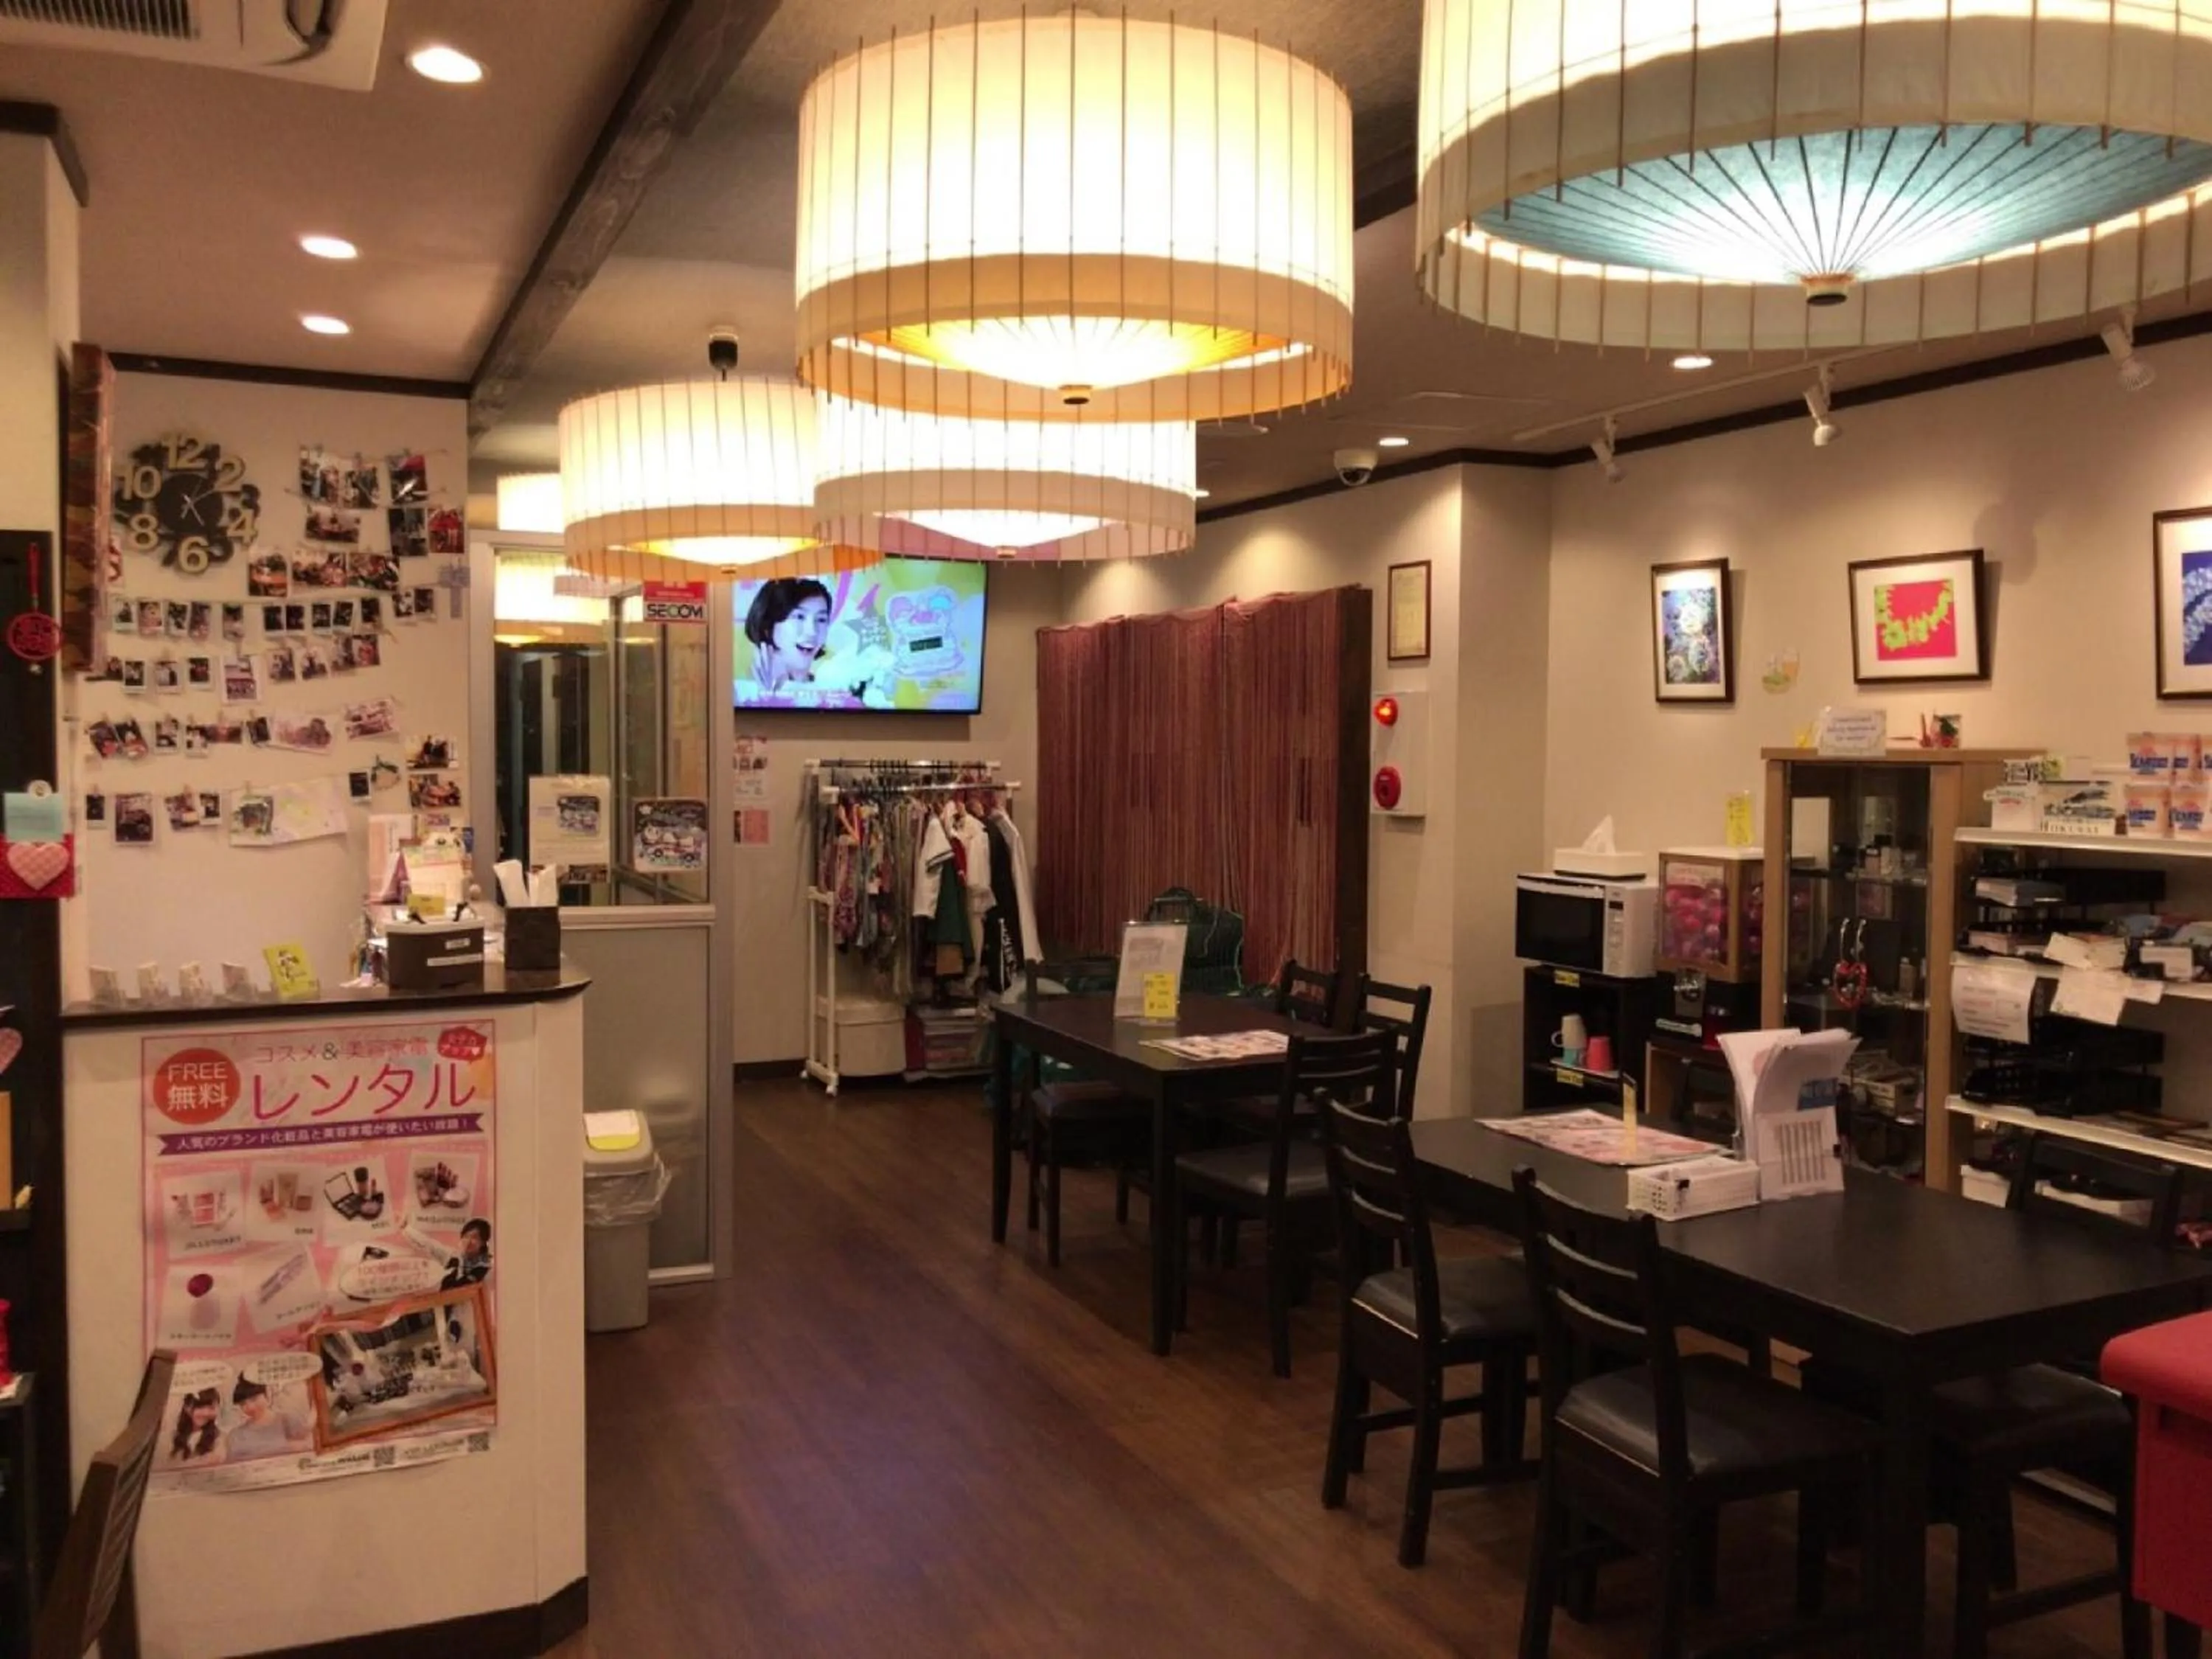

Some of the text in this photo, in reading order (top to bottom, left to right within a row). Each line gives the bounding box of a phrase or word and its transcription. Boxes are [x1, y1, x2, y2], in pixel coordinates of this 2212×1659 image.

[161, 431, 207, 470] 12
[113, 464, 162, 501] 10
[215, 453, 246, 493] 2
[127, 512, 159, 551] 8
[225, 508, 259, 547] 4
[177, 535, 209, 575] 6
[647, 604, 703, 619] SECOM
[167, 1061, 229, 1082] FREE
[253, 1062, 476, 1120] レンタル
[167, 1082, 229, 1112] 無料
